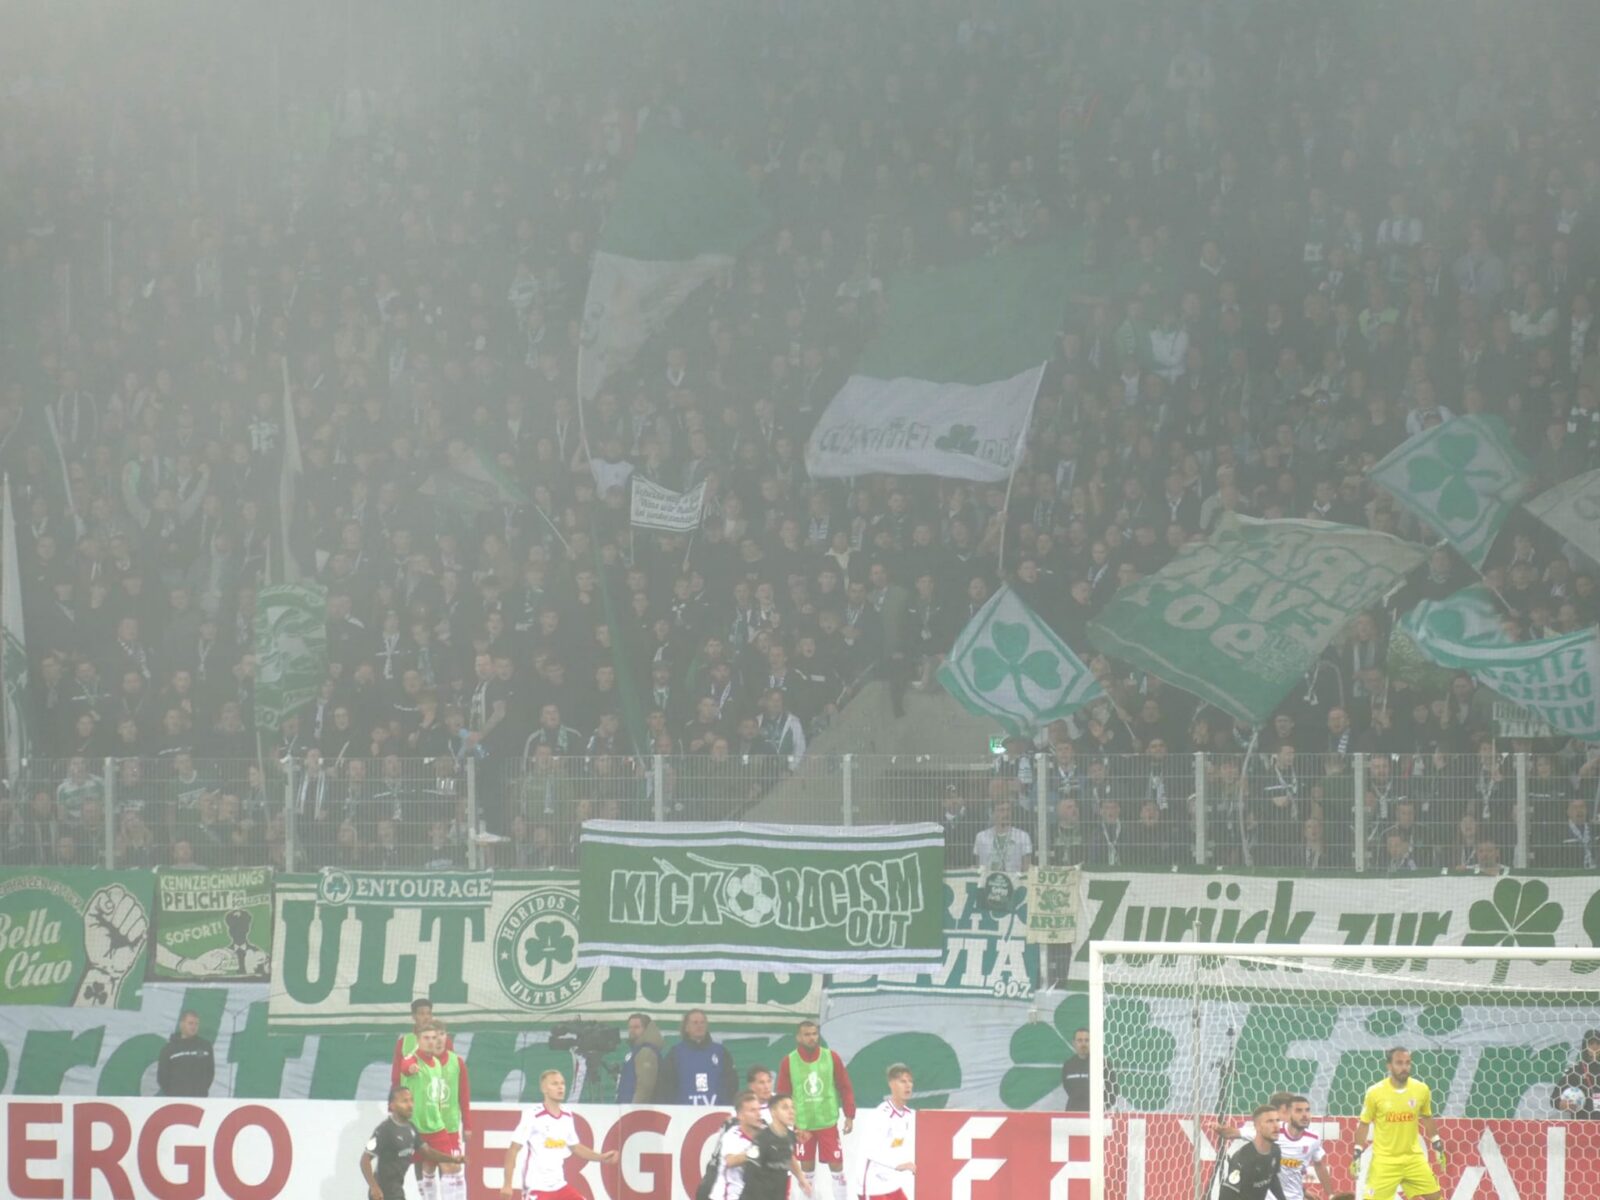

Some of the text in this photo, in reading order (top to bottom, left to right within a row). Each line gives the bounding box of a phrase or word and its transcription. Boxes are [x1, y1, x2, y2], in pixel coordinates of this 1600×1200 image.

[160, 870, 265, 891] KENNZEICHNUNGS
[355, 877, 491, 899] ENTOURAGE
[609, 862, 724, 926] KICK
[773, 852, 926, 931] RACISM
[1037, 871, 1070, 884] 907
[164, 891, 229, 909] PFLICHT
[502, 893, 567, 941] HORIDOS
[0, 908, 62, 953] Bella
[165, 921, 223, 945] SOFORT!
[845, 908, 911, 948] OUT
[1030, 915, 1076, 929] AREA
[1076, 880, 1453, 973] Zurück zur
[4, 951, 73, 990] Ciao
[509, 976, 583, 1007] ULTRAS
[7, 1102, 292, 1199] ERGO
